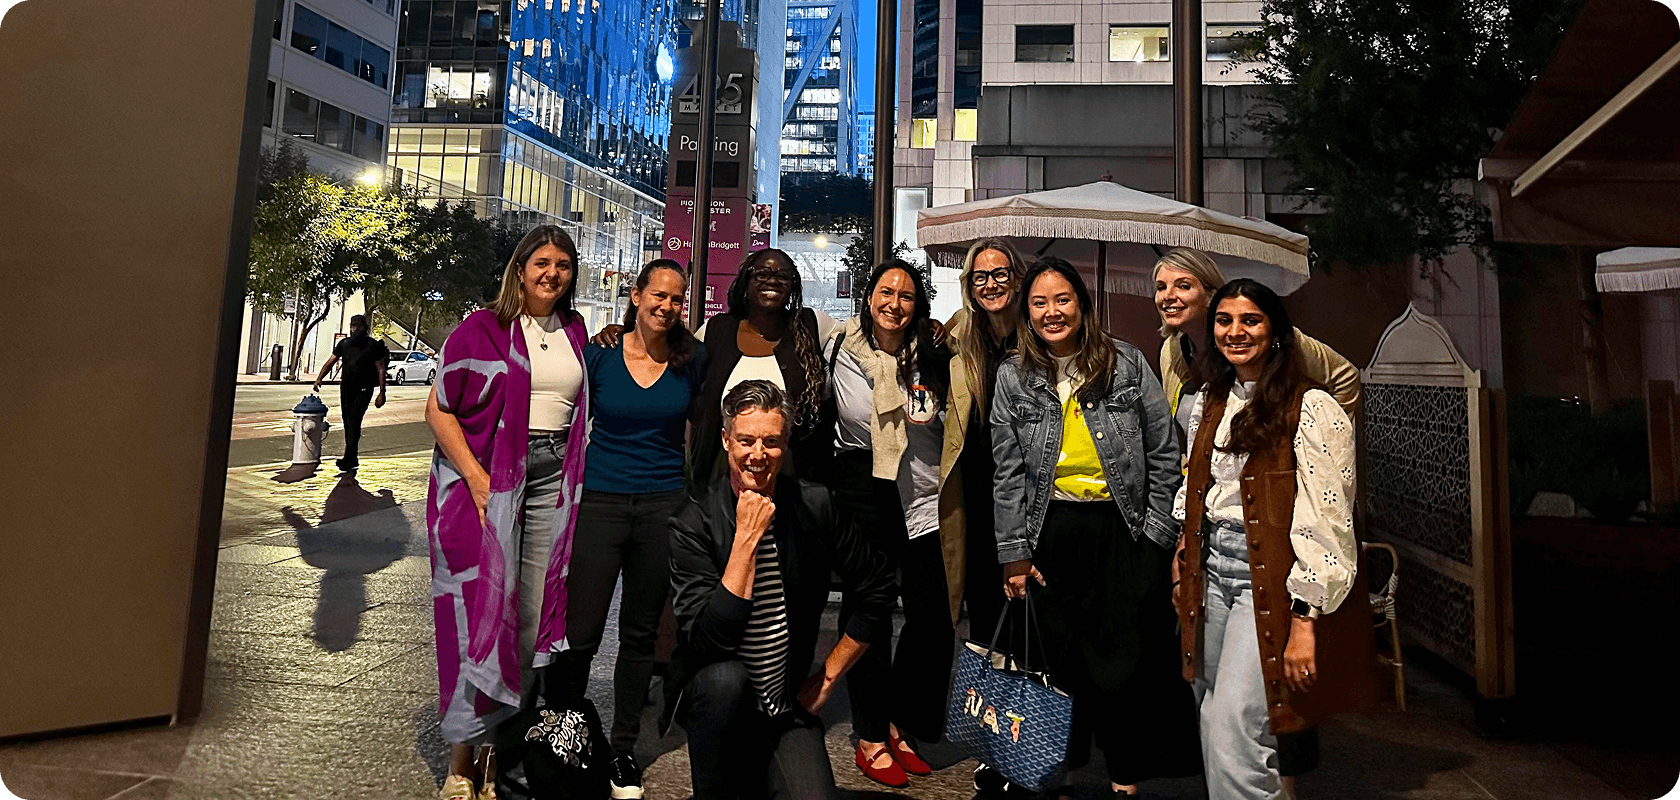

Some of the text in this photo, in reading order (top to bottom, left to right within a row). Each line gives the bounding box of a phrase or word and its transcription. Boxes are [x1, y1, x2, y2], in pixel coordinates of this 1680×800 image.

[684, 104, 738, 112] MAKET
[680, 135, 739, 156] Paing
[683, 240, 740, 250] HaBridgett
[964, 687, 1025, 743] NAT
